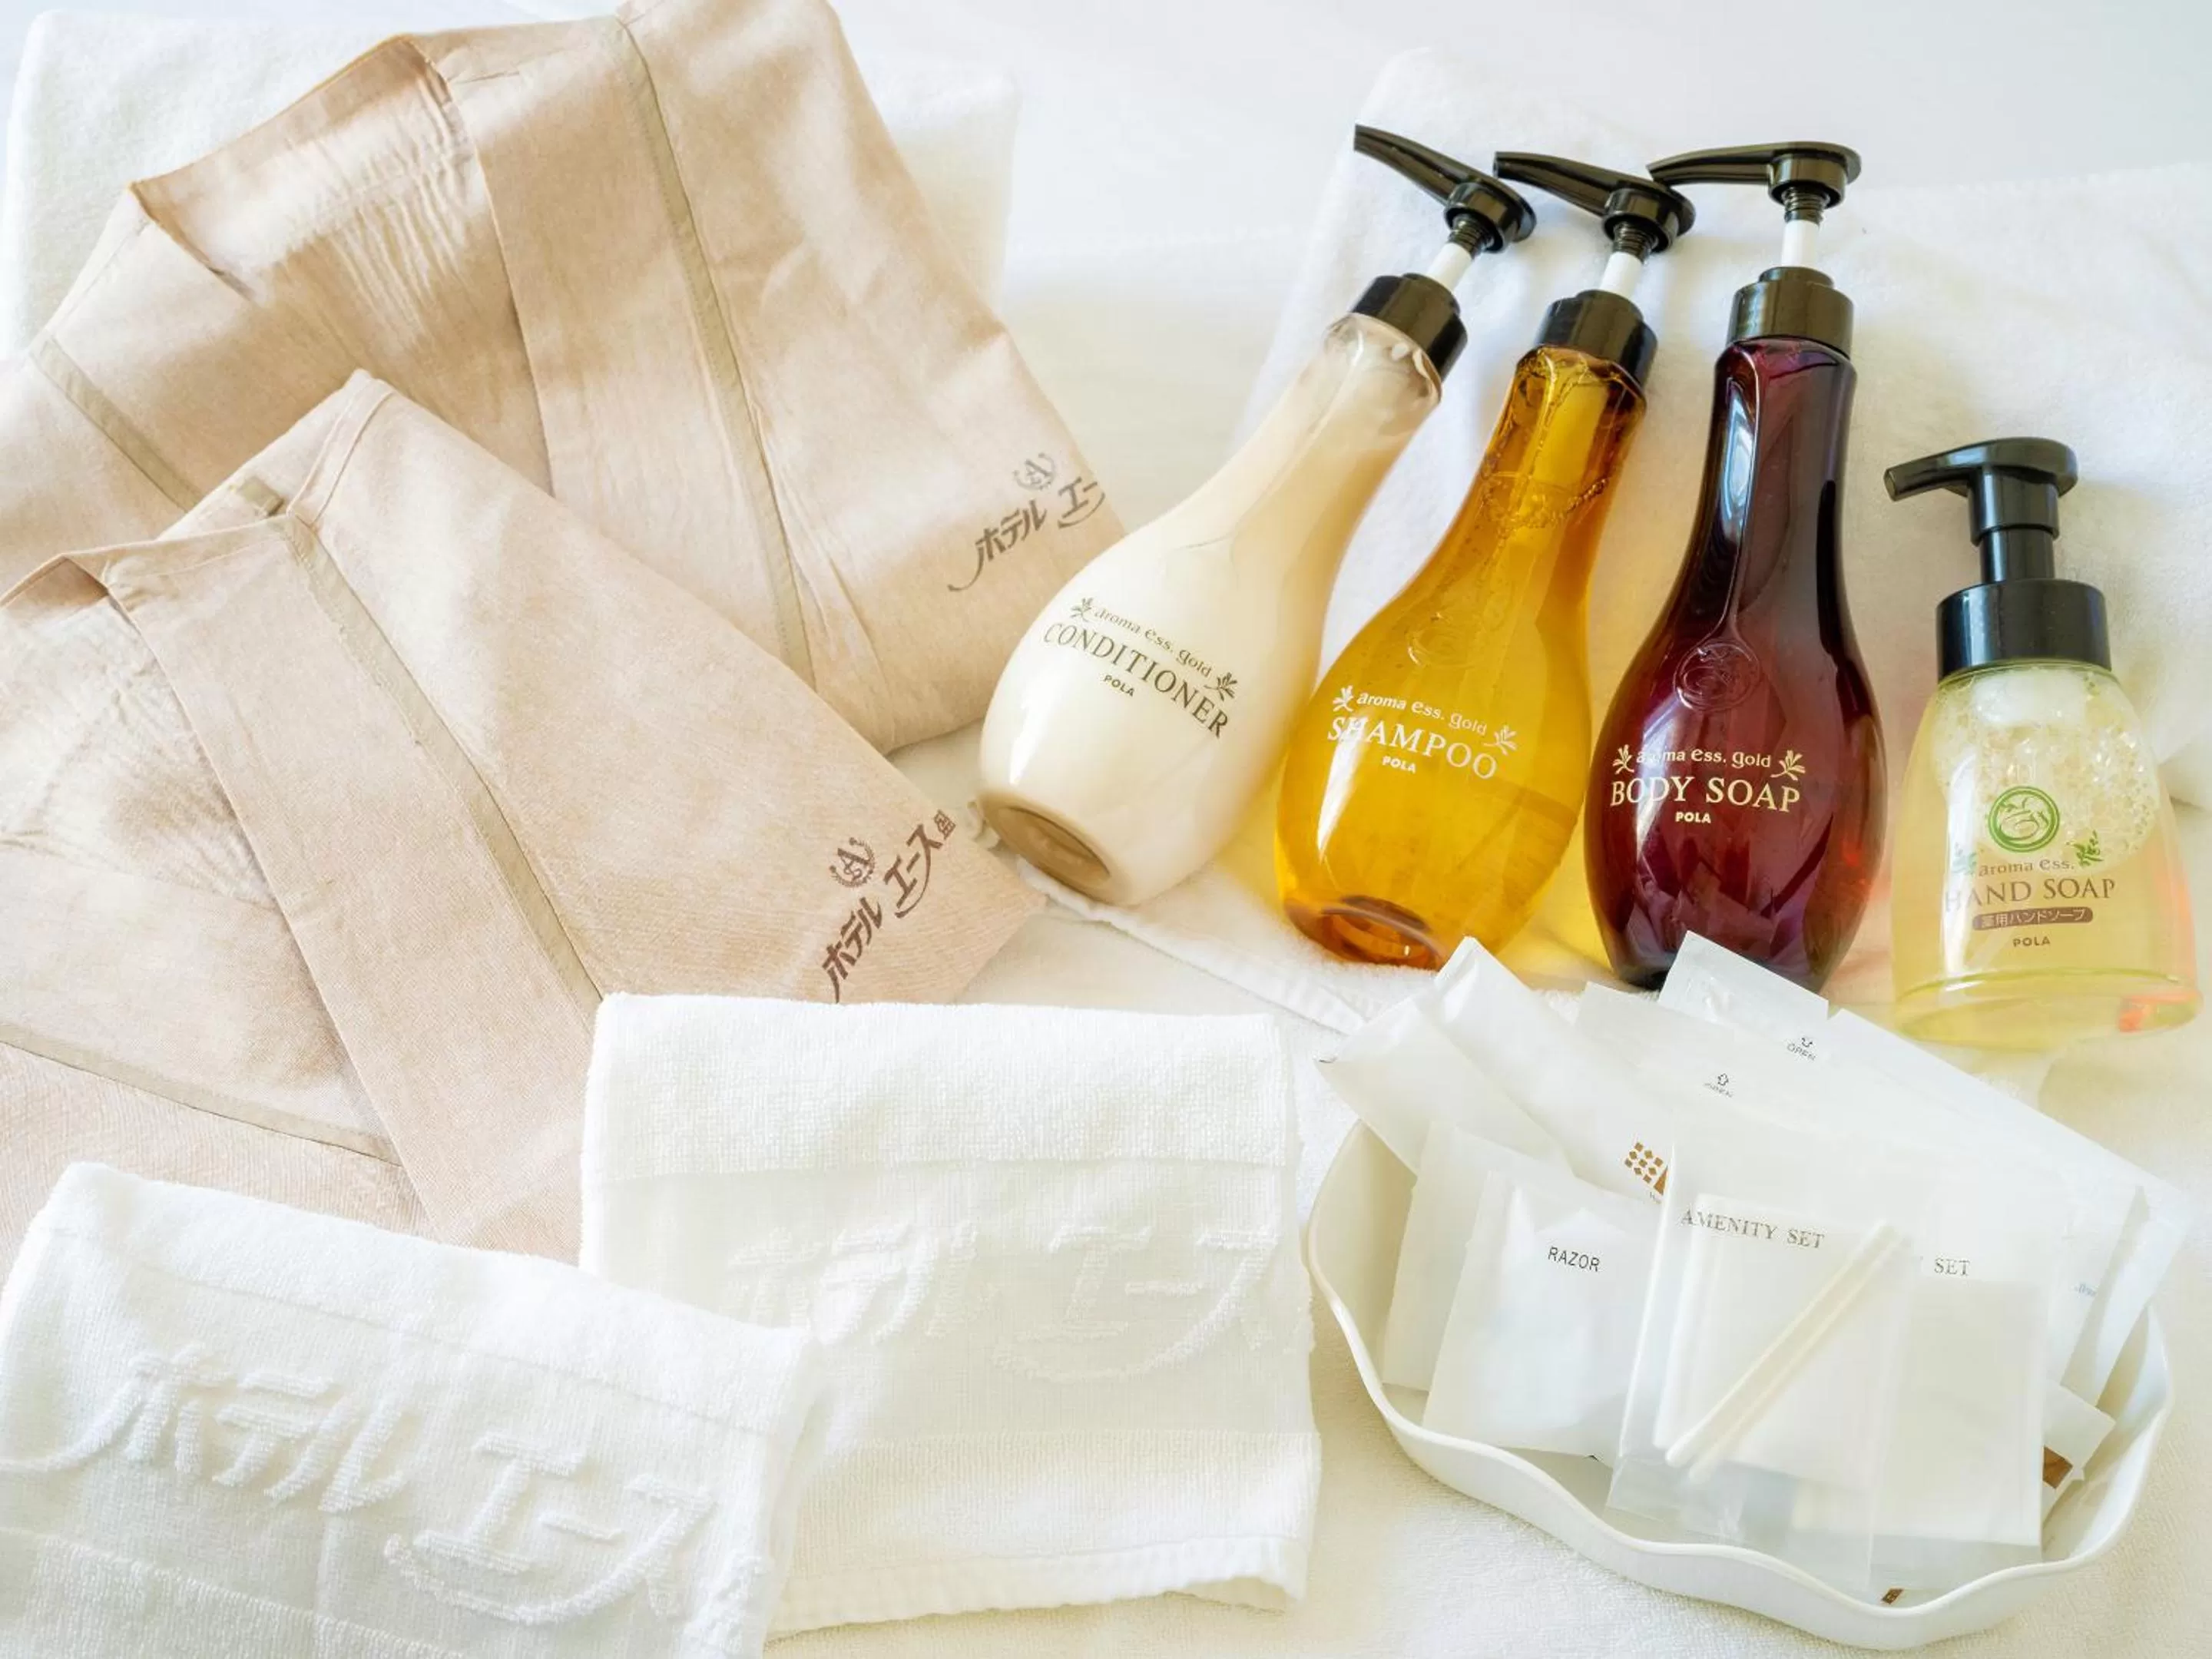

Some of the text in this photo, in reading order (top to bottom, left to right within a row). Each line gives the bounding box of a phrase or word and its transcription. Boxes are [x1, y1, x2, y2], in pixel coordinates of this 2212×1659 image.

[947, 498, 1047, 591] ホテル
[1093, 608, 1141, 635] aroma
[1175, 648, 1213, 678] gold
[1043, 622, 1229, 739] CONDITIONER
[1103, 674, 1135, 697] POLA
[1356, 692, 1407, 710] aroma
[1448, 711, 1488, 735] gold
[1326, 715, 1498, 780] SHAMPOO
[1730, 750, 1772, 769] gold
[1382, 755, 1417, 774] POLA
[1609, 776, 1801, 813] BODY SOAP
[1674, 810, 1712, 824] POLA
[1978, 861, 2034, 877] aroma
[2042, 877, 2116, 900] SOAP
[821, 823, 944, 1003] ホテル エース
[2012, 936, 2051, 948] POLA
[1681, 1208, 1826, 1249] AMENITY SET
[1548, 1246, 1601, 1272] RAZOR
[1933, 1257, 1971, 1277] SET
